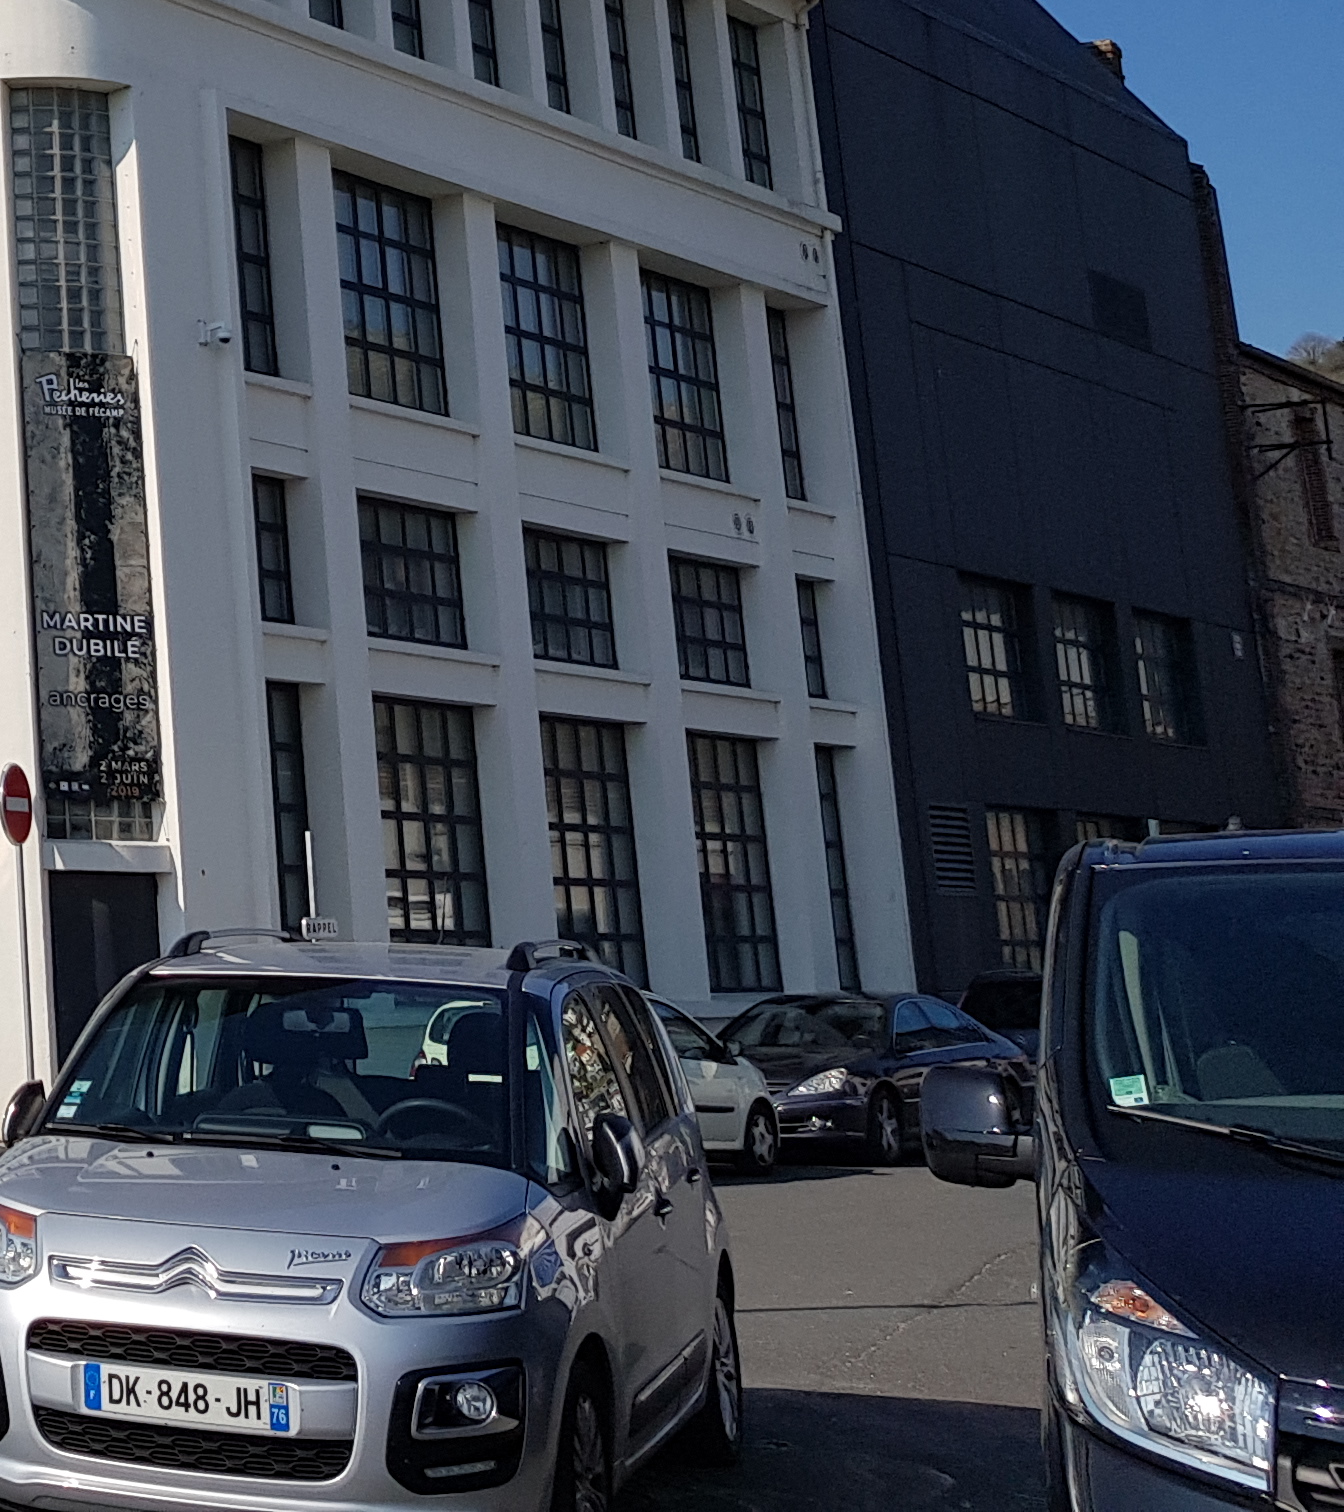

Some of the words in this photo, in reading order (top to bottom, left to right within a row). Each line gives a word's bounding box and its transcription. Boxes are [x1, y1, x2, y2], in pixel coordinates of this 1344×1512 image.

[75, 407, 87, 416] DE
[41, 611, 148, 633] MARTINE
[54, 637, 141, 658] DUBILÉ
[49, 691, 150, 712] ancrages
[99, 761, 107, 771] 2
[111, 761, 148, 772] MARS
[100, 773, 108, 784] 2
[114, 773, 149, 784] JUIN
[111, 785, 140, 797] 2019
[307, 922, 337, 933] RAPPEL
[107, 1372, 262, 1420] DK-848-JH
[271, 1408, 287, 1424] 76
